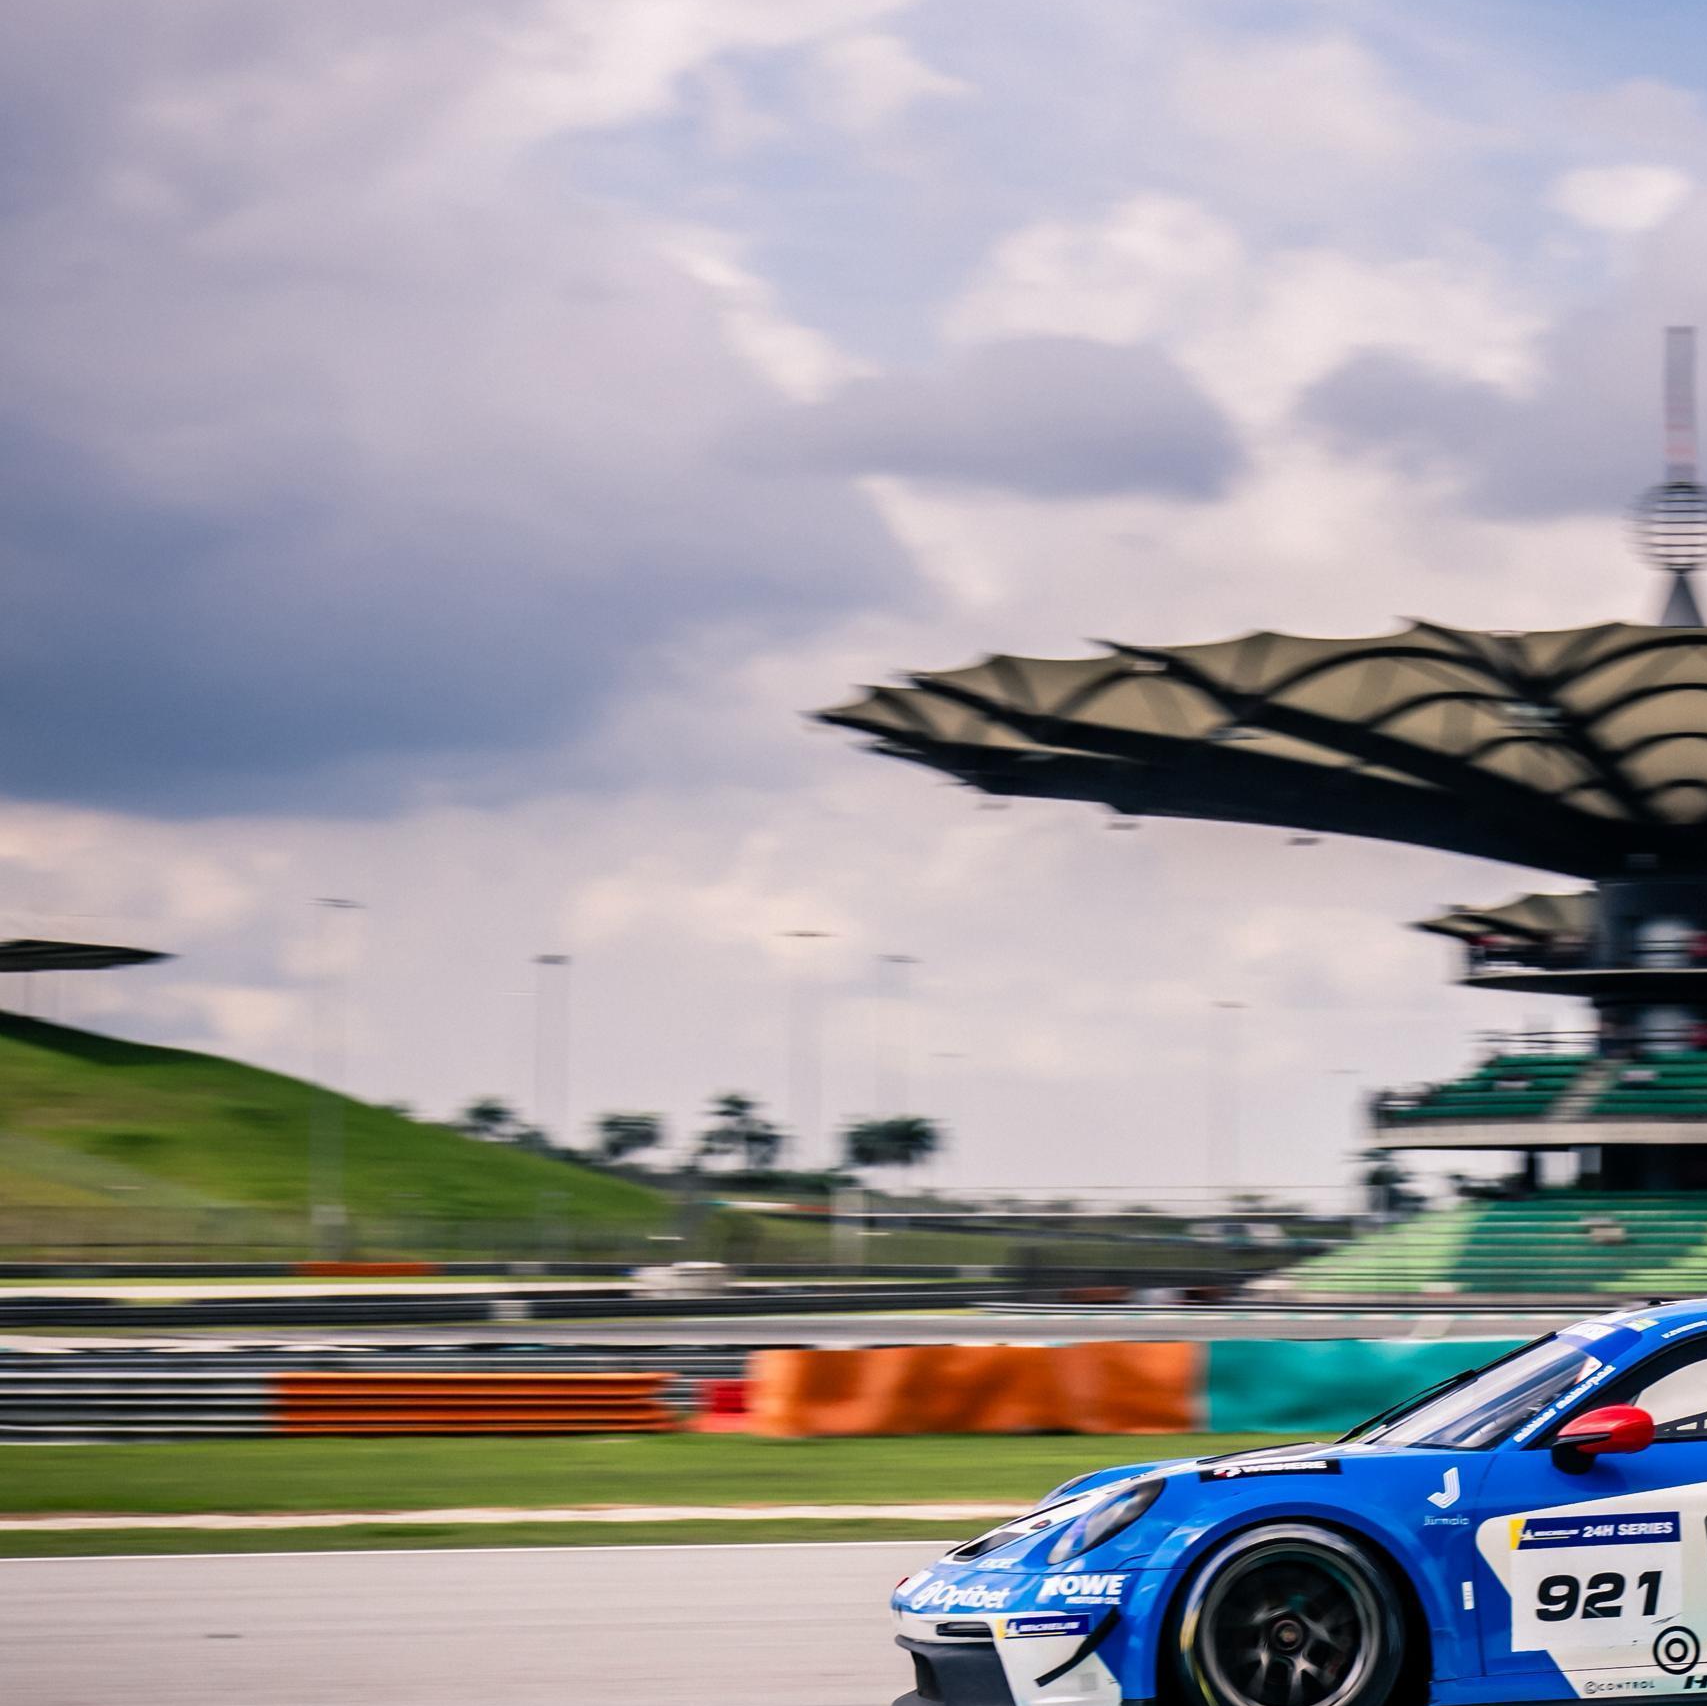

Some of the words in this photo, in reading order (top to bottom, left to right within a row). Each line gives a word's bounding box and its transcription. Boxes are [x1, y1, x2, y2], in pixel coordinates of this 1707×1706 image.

[1582, 1524, 1614, 1538] 24H
[1617, 1522, 1674, 1536] SERIES
[1039, 1574, 1128, 1597] ROWE
[1535, 1570, 1663, 1622] 921
